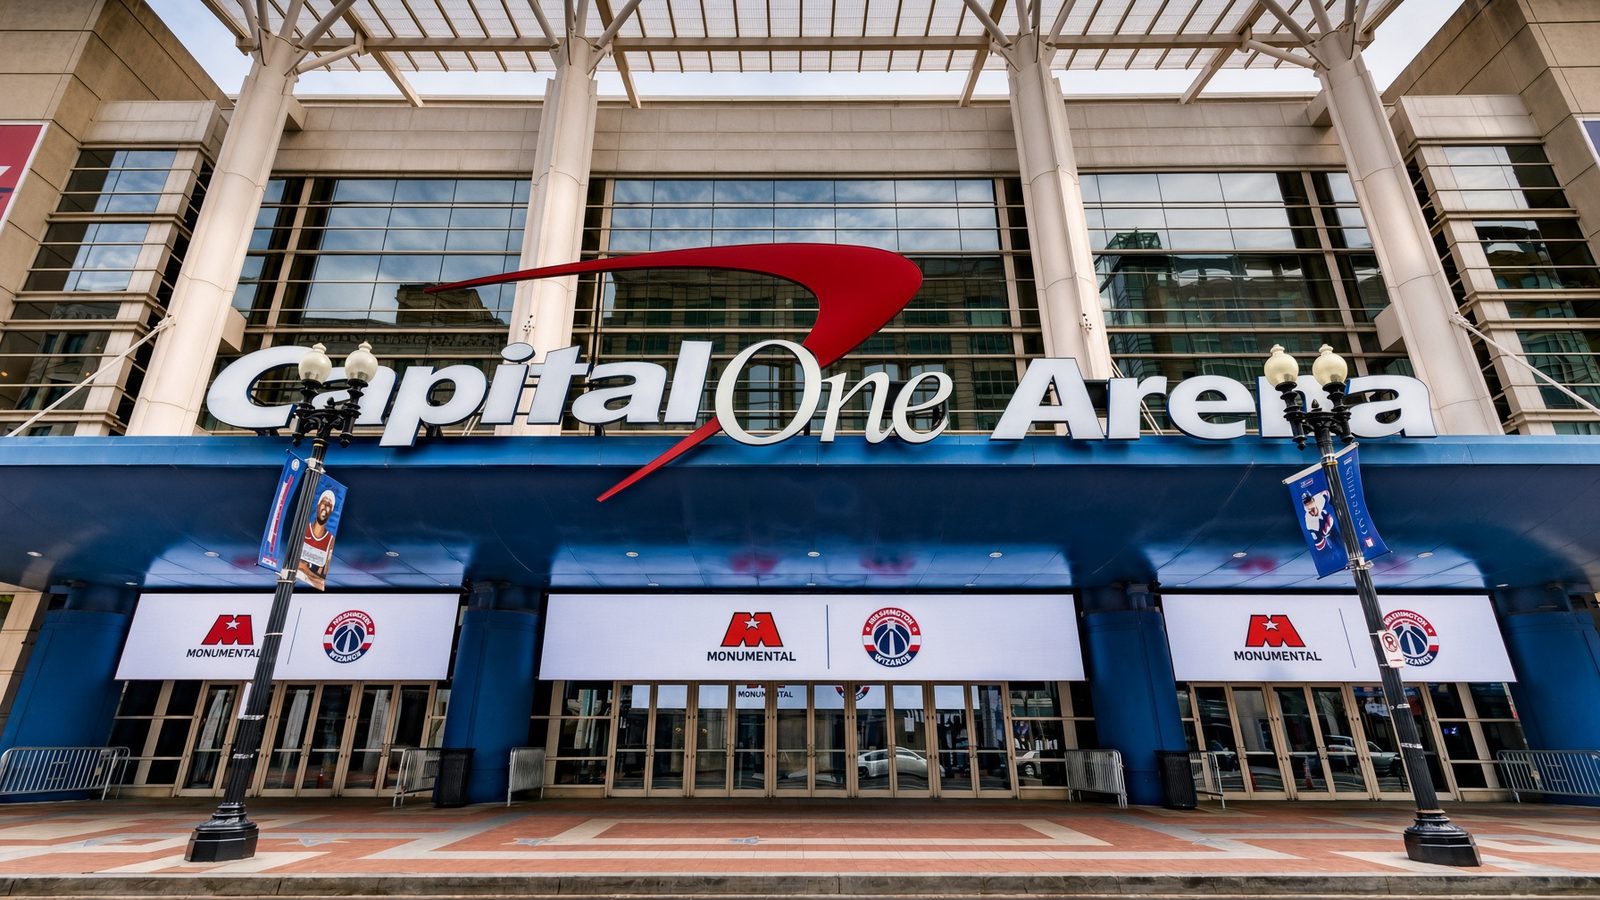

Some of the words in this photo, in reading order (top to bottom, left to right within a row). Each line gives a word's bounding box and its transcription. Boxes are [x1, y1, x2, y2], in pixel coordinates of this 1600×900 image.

[206, 340, 713, 447] Capital
[715, 339, 954, 446] One
[989, 357, 1438, 440] Arena
[186, 648, 261, 658] MONUMENTAL
[707, 651, 796, 662] MONUMENTAL
[1233, 651, 1322, 661] MONUMENTAL
